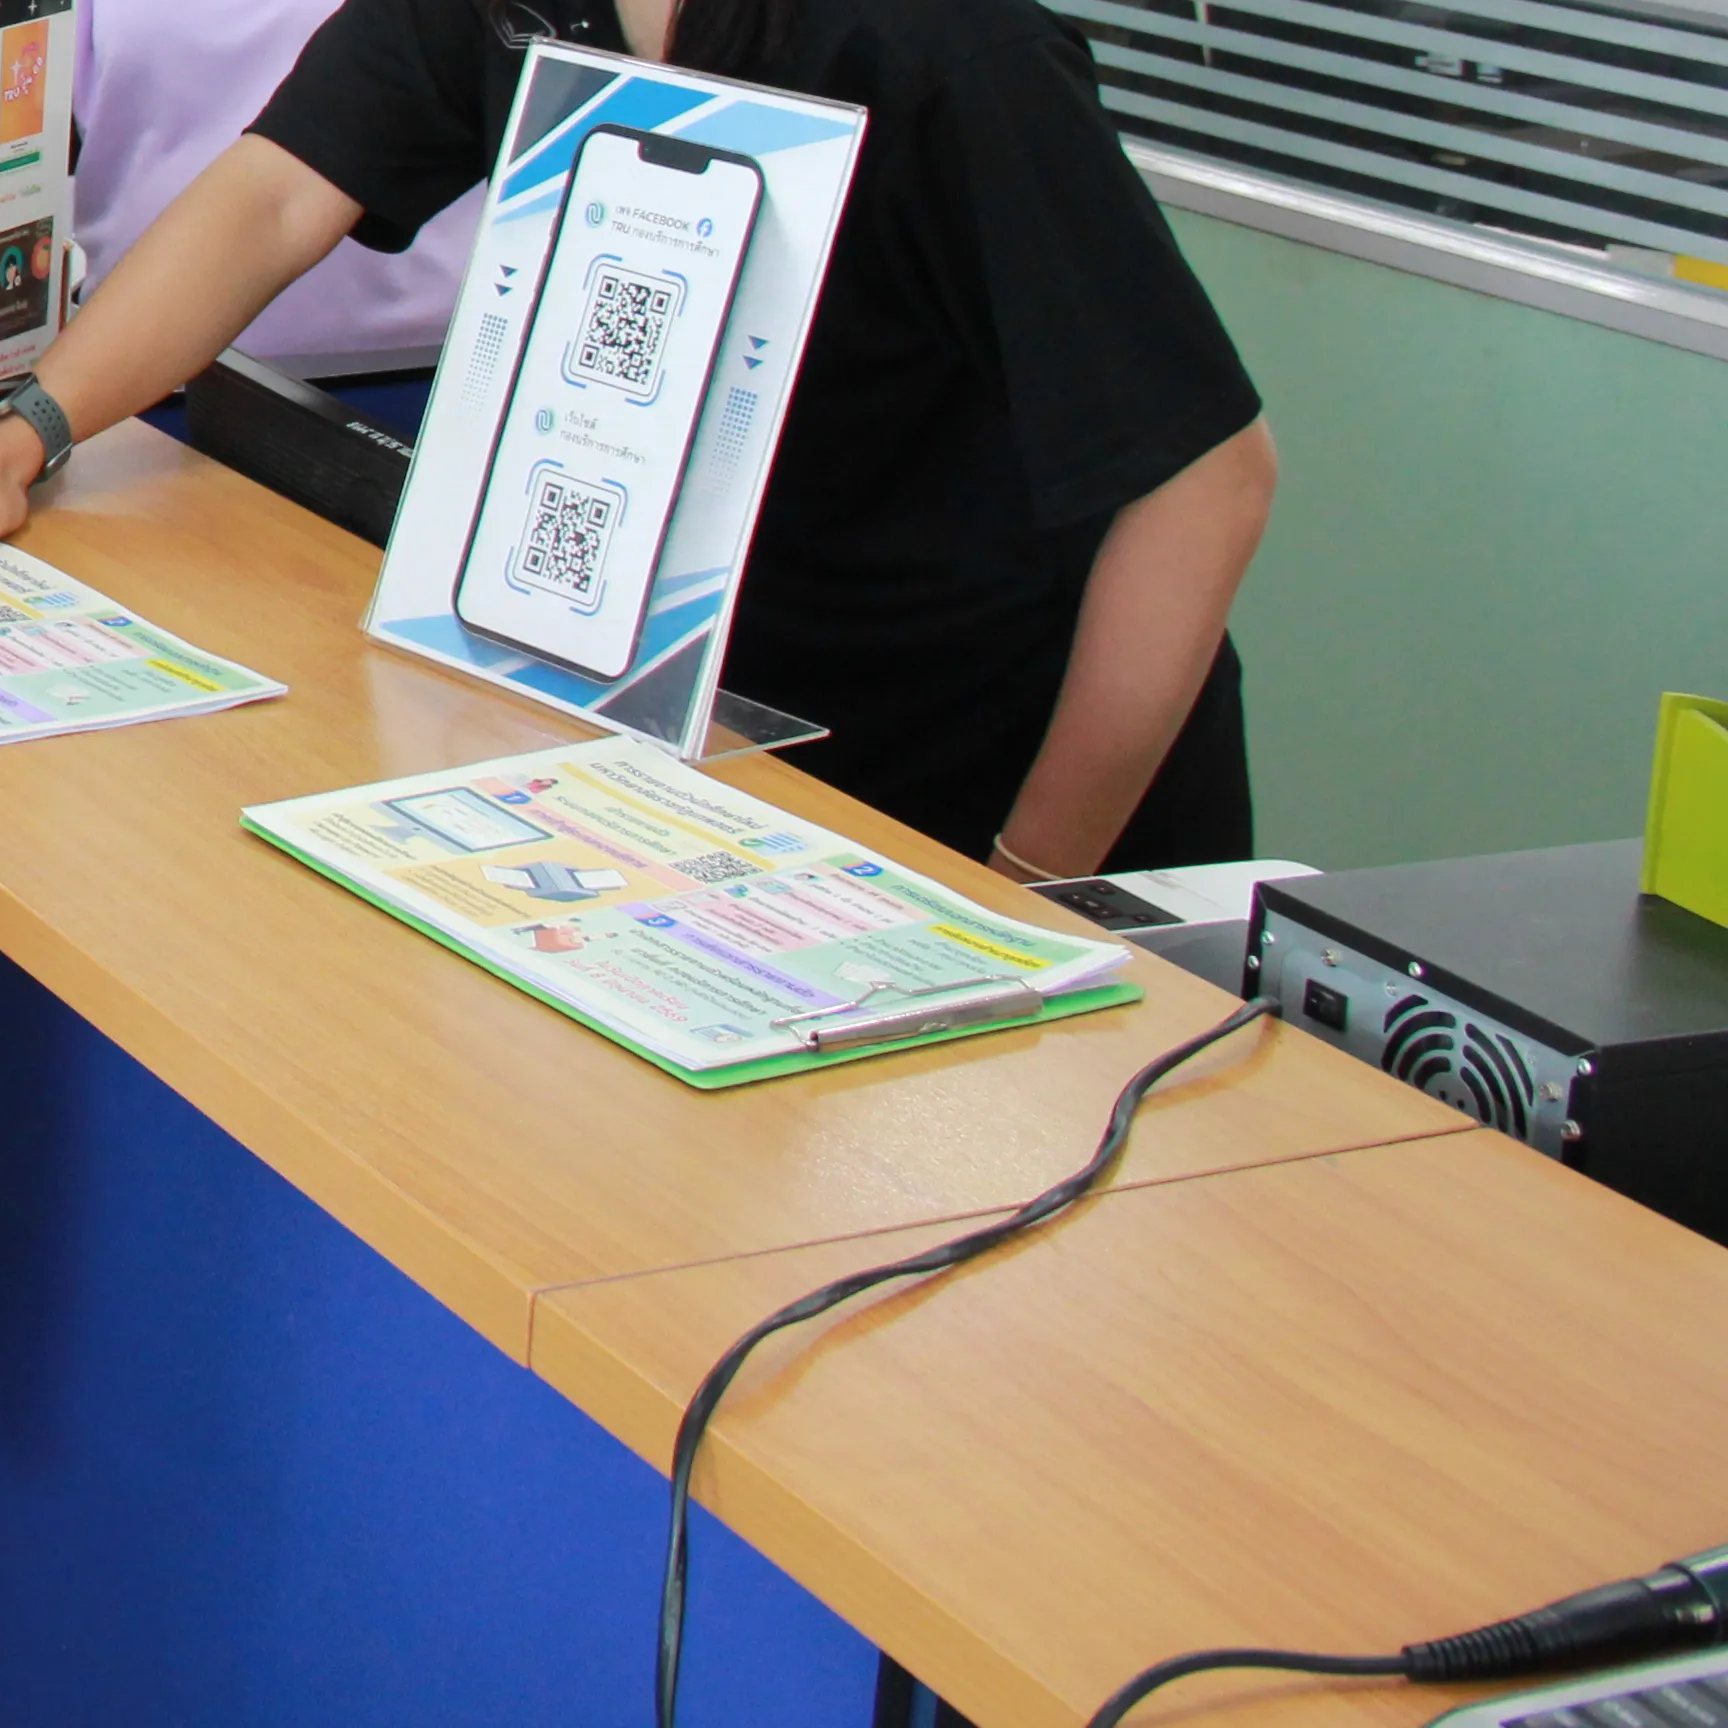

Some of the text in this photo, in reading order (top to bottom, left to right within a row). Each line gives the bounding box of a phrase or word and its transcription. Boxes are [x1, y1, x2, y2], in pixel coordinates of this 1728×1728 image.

[632, 208, 690, 232] FACEBOOK
[612, 221, 720, 258] TRU กองบริการการศึกษา
[560, 429, 646, 466] กองบริการการศึกษา
